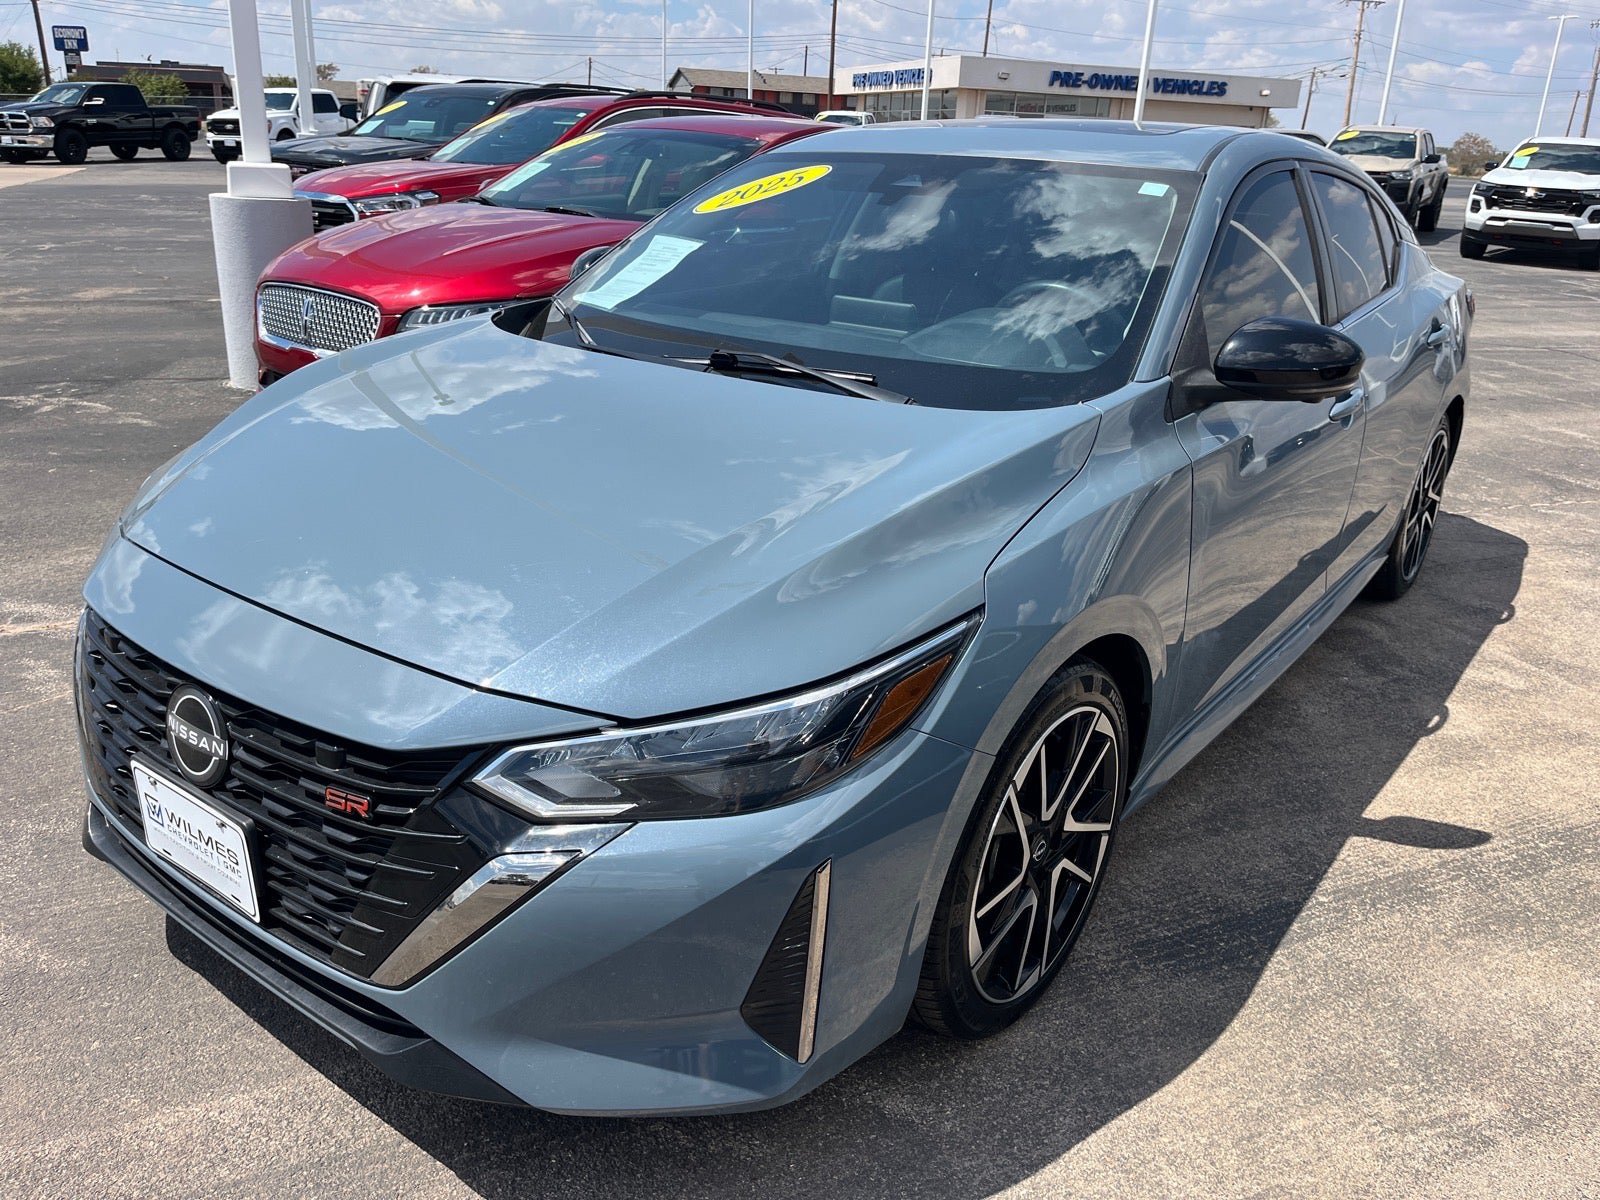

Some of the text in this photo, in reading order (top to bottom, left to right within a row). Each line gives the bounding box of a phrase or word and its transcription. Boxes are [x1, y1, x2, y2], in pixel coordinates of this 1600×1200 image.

[53, 28, 84, 39] ECONOMY
[63, 39, 78, 49] INN
[853, 71, 893, 87] PRE-OWNED
[1049, 71, 1228, 97] PRE-OWNE VEHICLES
[715, 170, 810, 208] 2025
[167, 718, 224, 757] NISSAN
[325, 787, 370, 818] SR
[165, 807, 239, 866] WILMES
[167, 824, 214, 860] CHEVROLET
[223, 861, 242, 879] GMC
